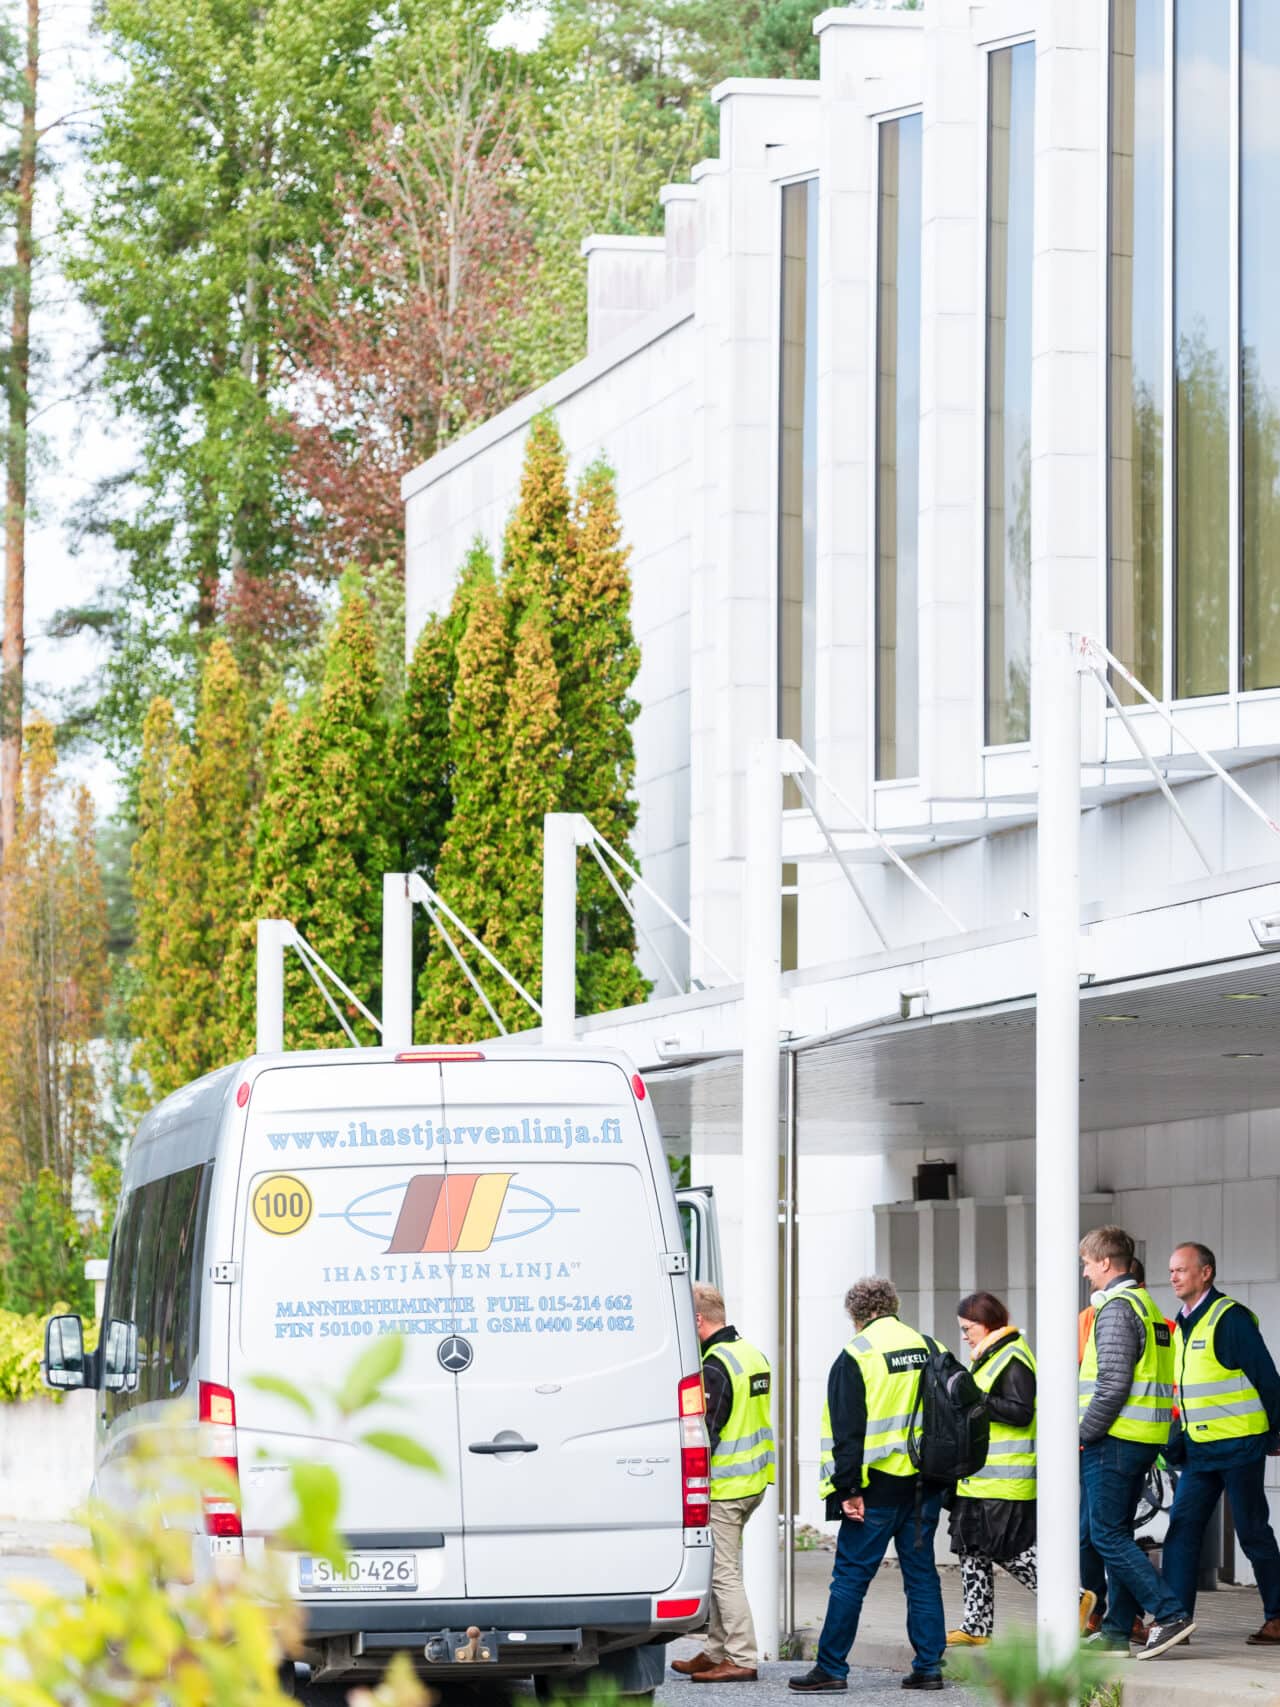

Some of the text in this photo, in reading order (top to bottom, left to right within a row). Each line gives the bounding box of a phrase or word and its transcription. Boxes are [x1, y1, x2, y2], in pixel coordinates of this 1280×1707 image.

[267, 1118, 623, 1150] www.ihastjarvenlinja.fi
[260, 1192, 304, 1218] 100
[323, 1261, 491, 1283] IHASTJÄRVEN
[500, 1262, 571, 1281] LINJA
[275, 1297, 475, 1318] MANNERHEIMINTIE
[538, 1295, 601, 1312] 015-214
[605, 1295, 633, 1311] 662
[275, 1315, 635, 1338] FIN 50100 MIKKELI GSM 0400 564 082
